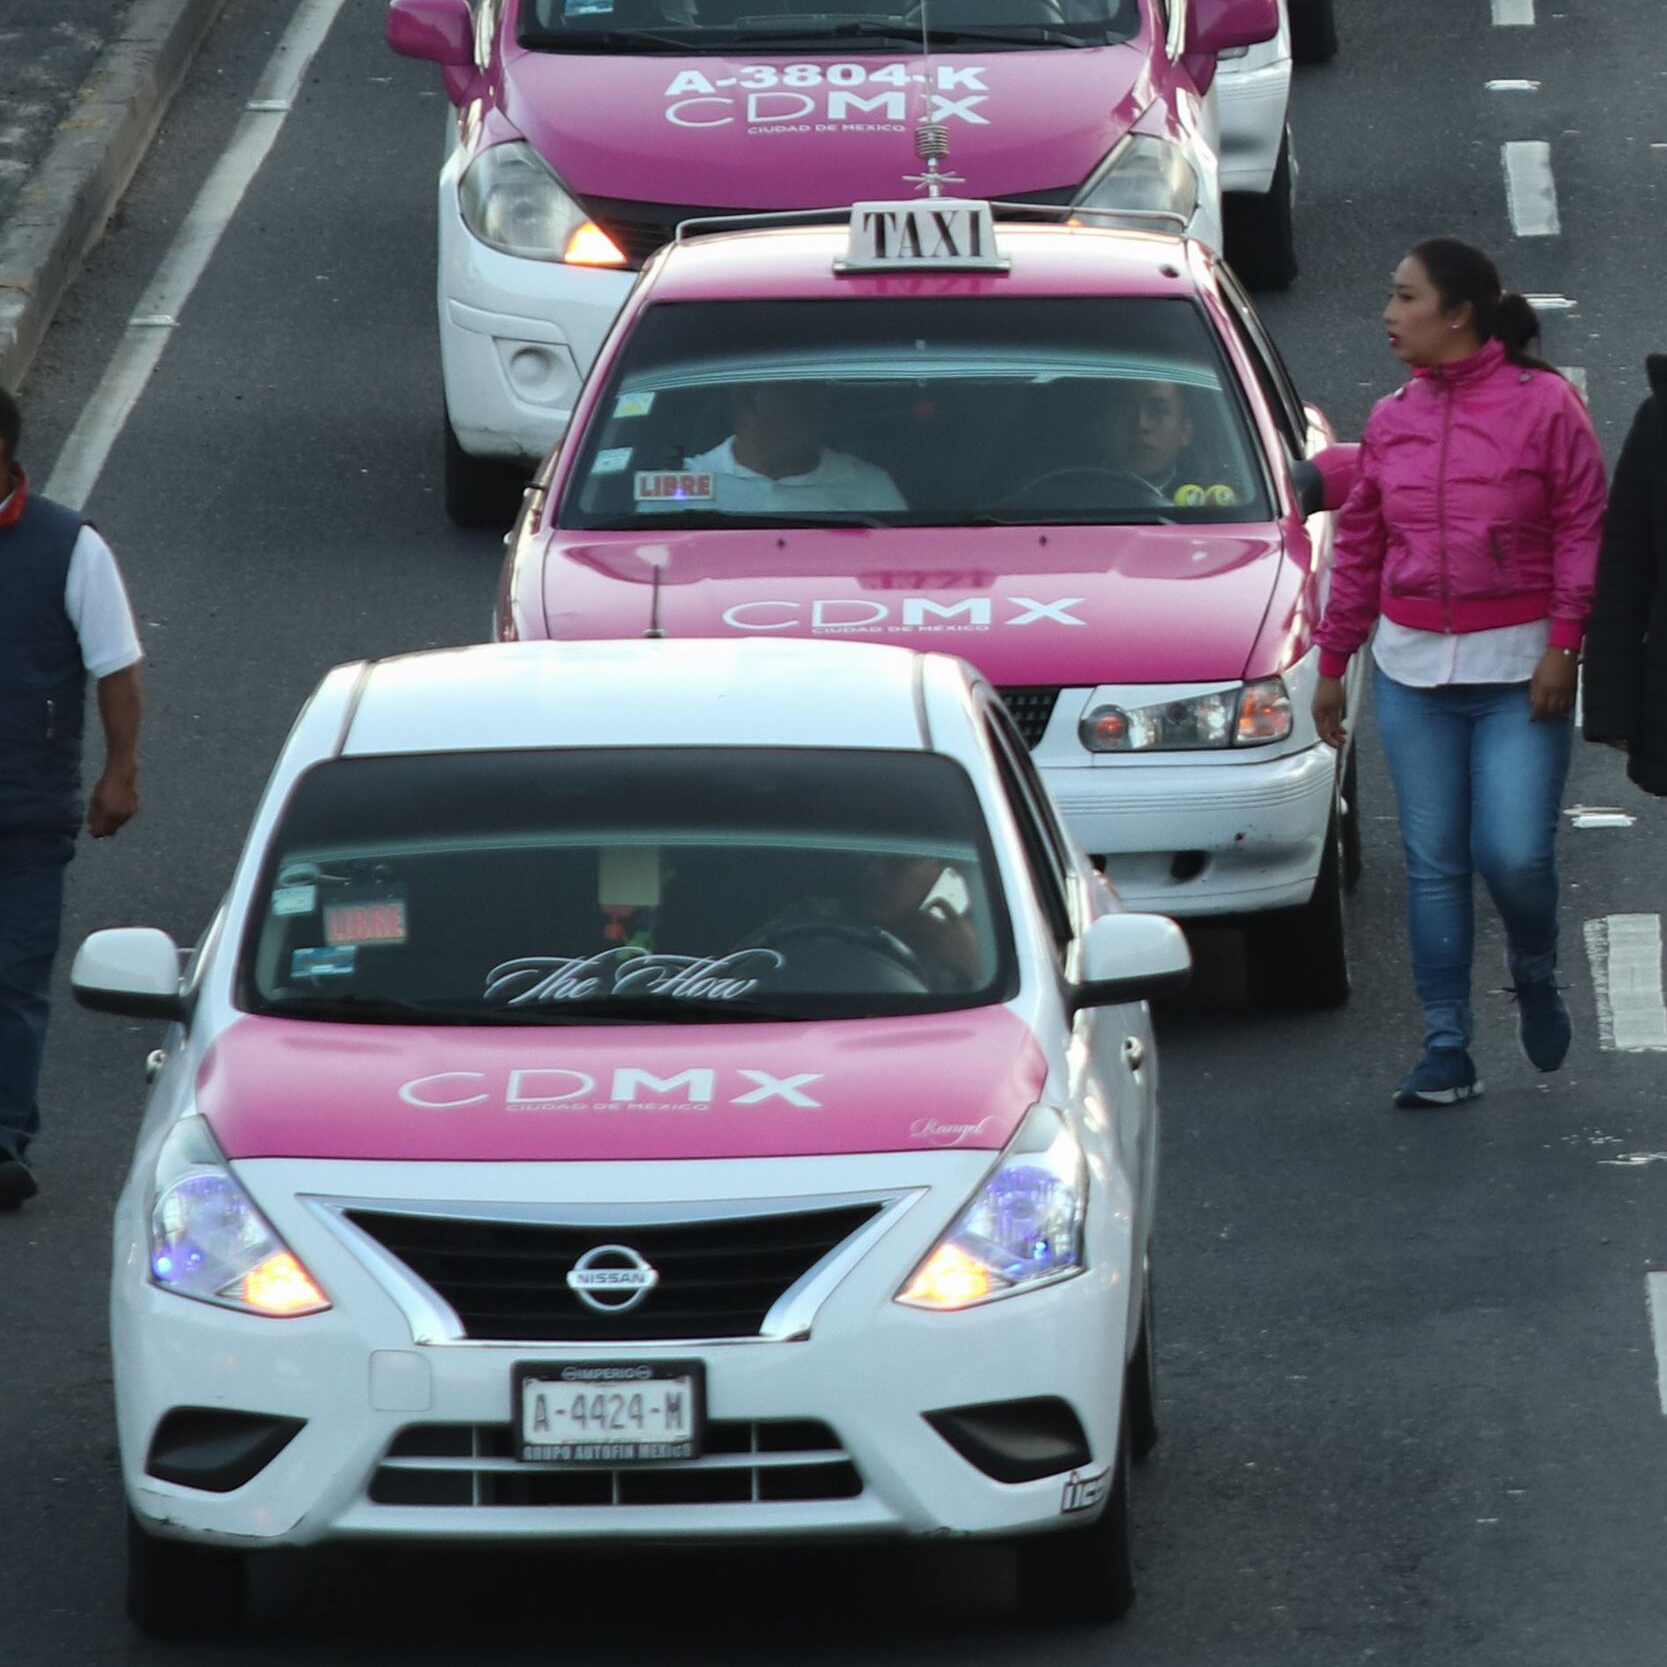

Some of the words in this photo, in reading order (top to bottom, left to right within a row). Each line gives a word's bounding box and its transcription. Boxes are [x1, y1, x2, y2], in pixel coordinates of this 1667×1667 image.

[664, 63, 990, 96] A-3804-K
[664, 90, 991, 128] CDMX
[815, 123, 837, 132] DE
[863, 211, 984, 259] TAXI
[639, 474, 711, 497] LIBRE
[721, 597, 1088, 630] CDMX
[483, 946, 650, 1004] The
[398, 1067, 827, 1109] CDMX
[578, 1272, 646, 1286] NISSAN
[533, 1391, 683, 1432] A-4424-M
[523, 1445, 572, 1461] GRUPO
